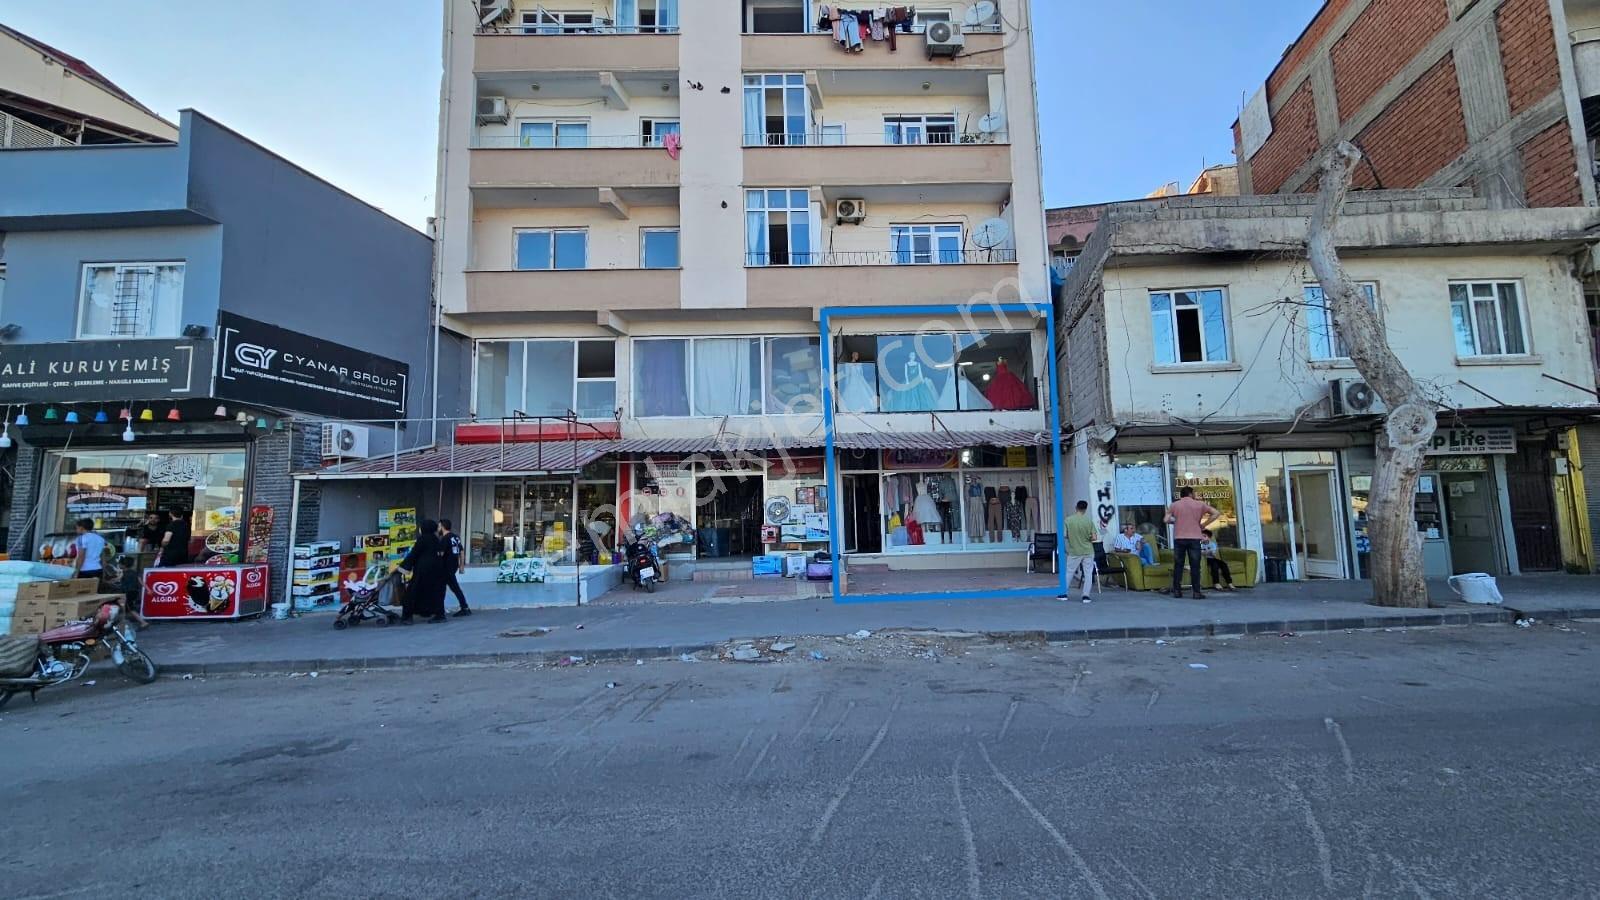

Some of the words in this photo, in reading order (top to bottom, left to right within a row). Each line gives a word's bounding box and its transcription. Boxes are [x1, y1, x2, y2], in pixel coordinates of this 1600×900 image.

[1, 360, 36, 375] ALİ
[49, 356, 172, 374] KURUYEMİŞ
[283, 352, 349, 377] CYANAR
[353, 370, 398, 387] GROUP
